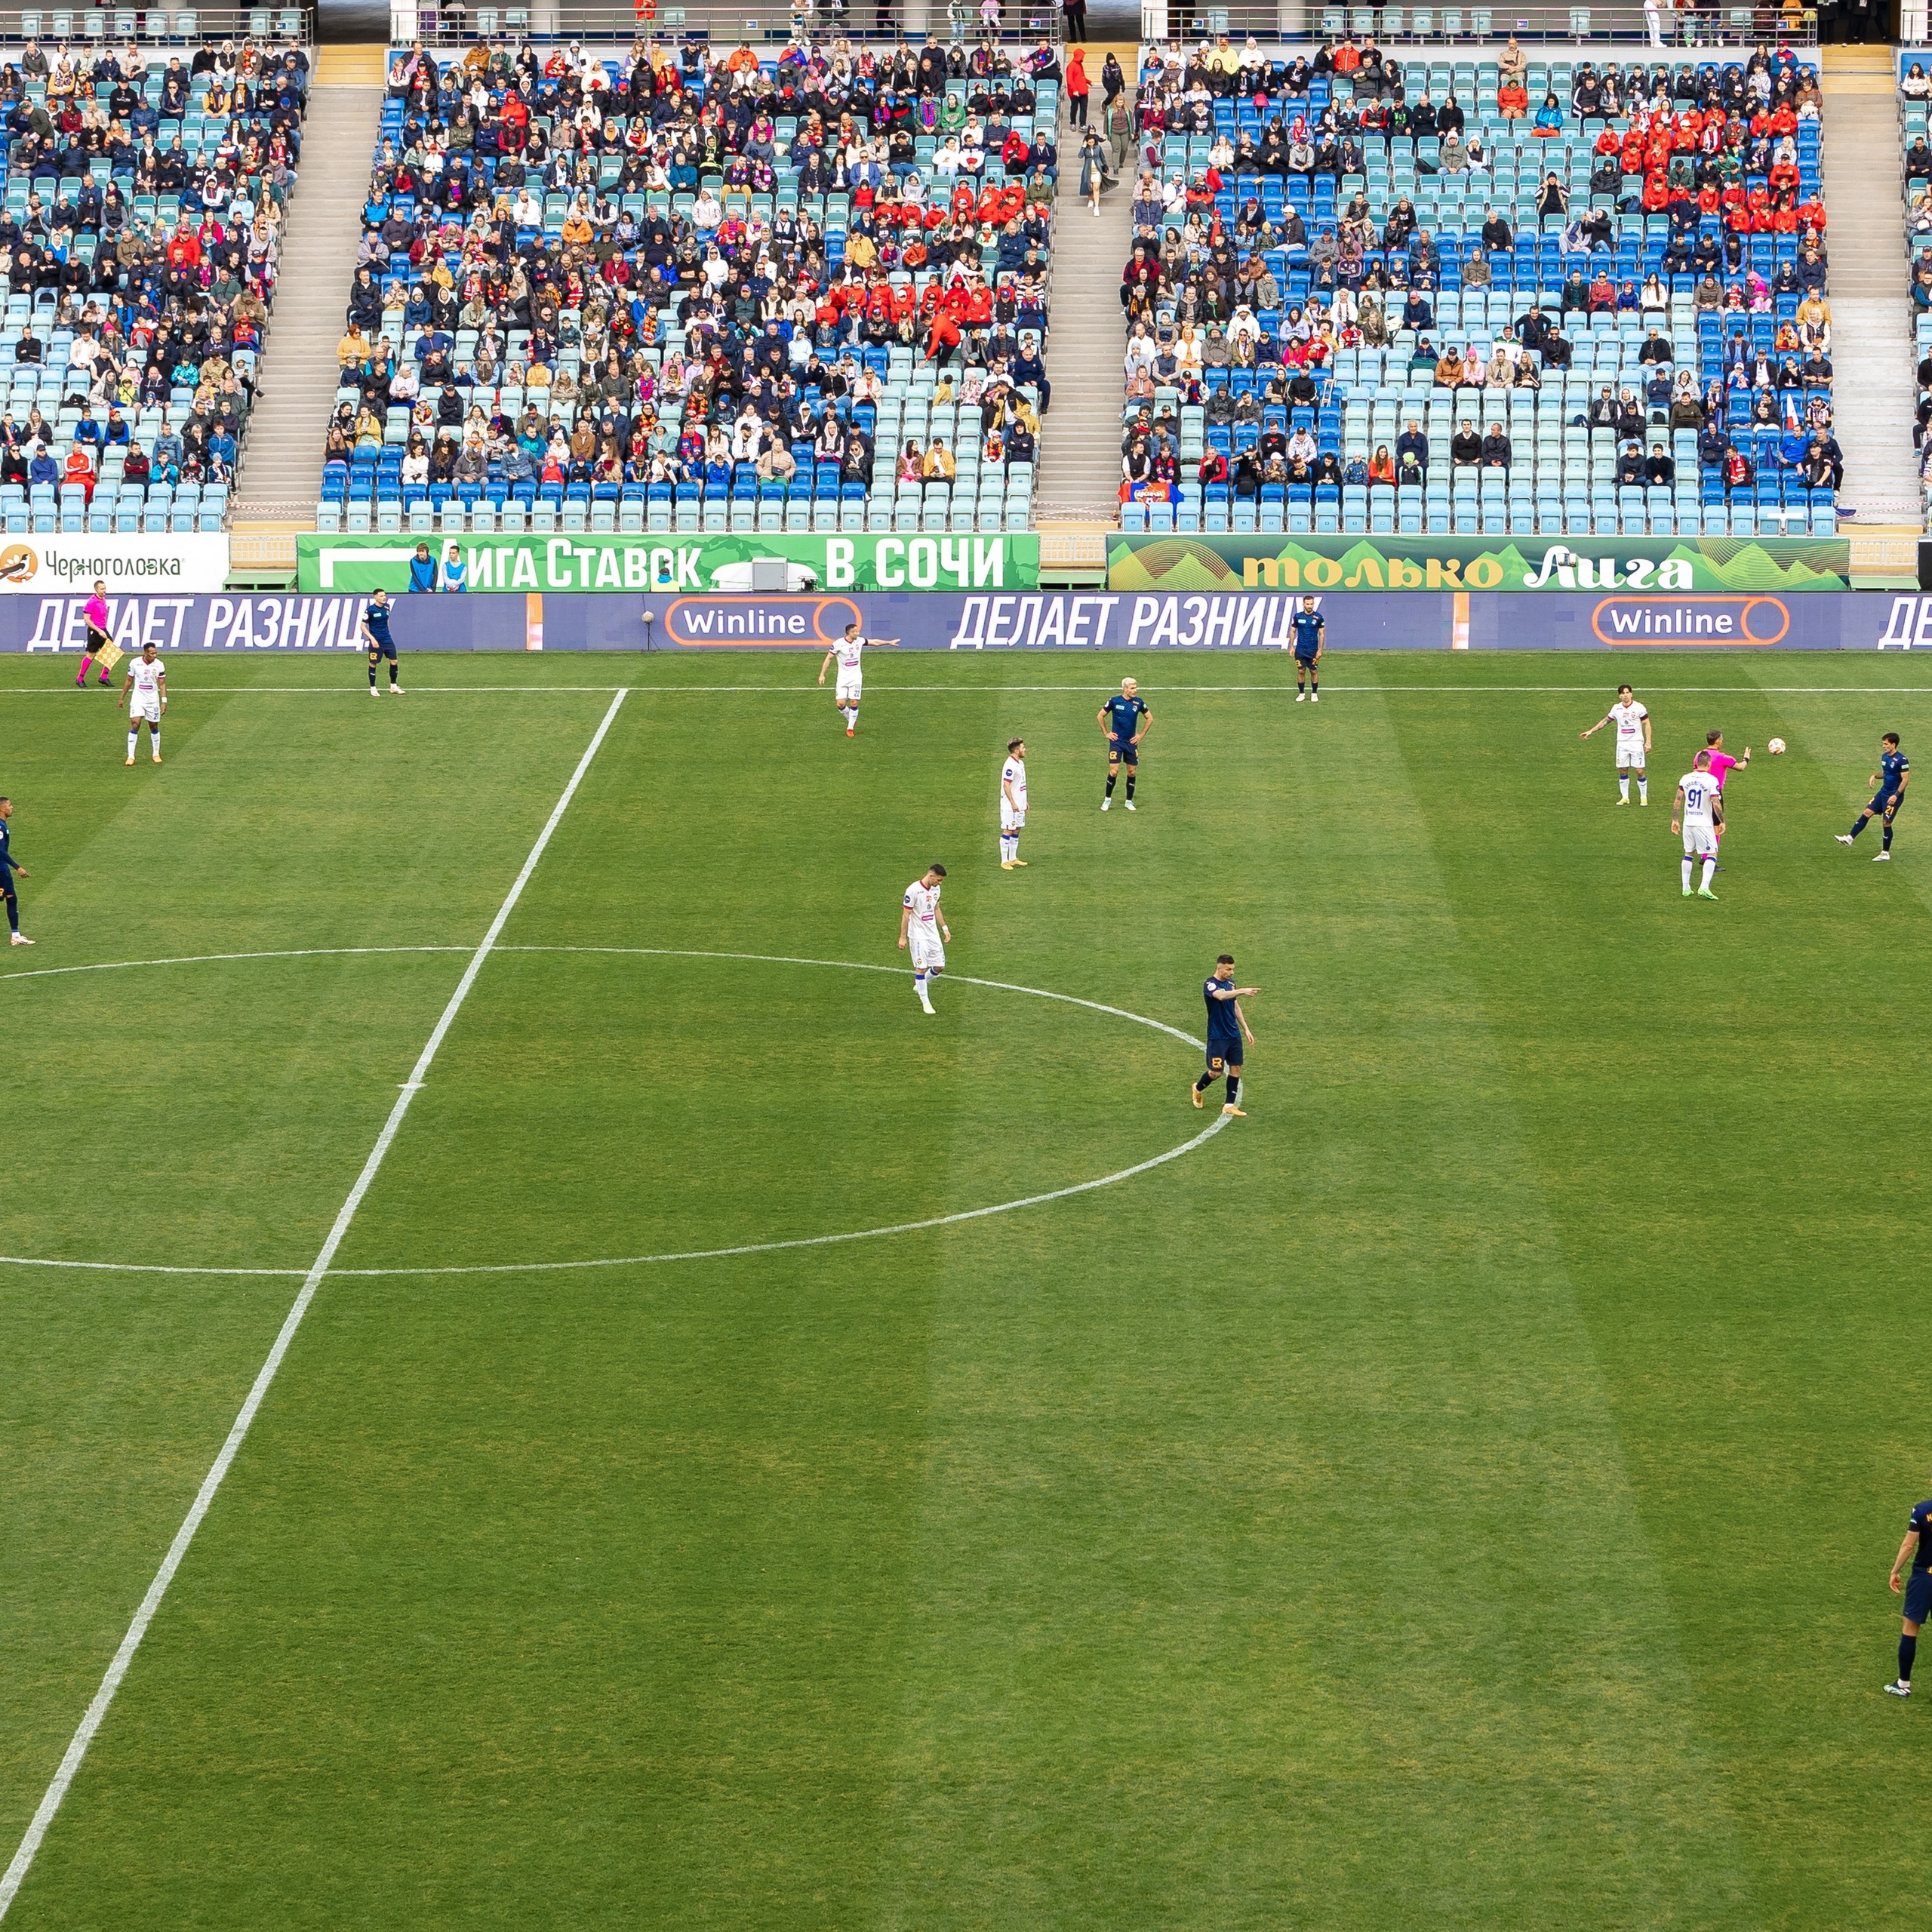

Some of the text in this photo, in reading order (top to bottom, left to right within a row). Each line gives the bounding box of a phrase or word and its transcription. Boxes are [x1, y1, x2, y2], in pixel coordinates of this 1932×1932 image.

[45, 550, 181, 583] Черноголовка
[826, 538, 855, 587] В
[875, 537, 1004, 587] СОЧИ
[1522, 545, 1694, 589] Лига
[683, 610, 806, 635] Winline
[949, 596, 1119, 650] ДЕЛАЕТ
[1611, 609, 1734, 635] Winline
[1687, 789, 1702, 809] 91
[1884, 805, 1895, 815] 21
